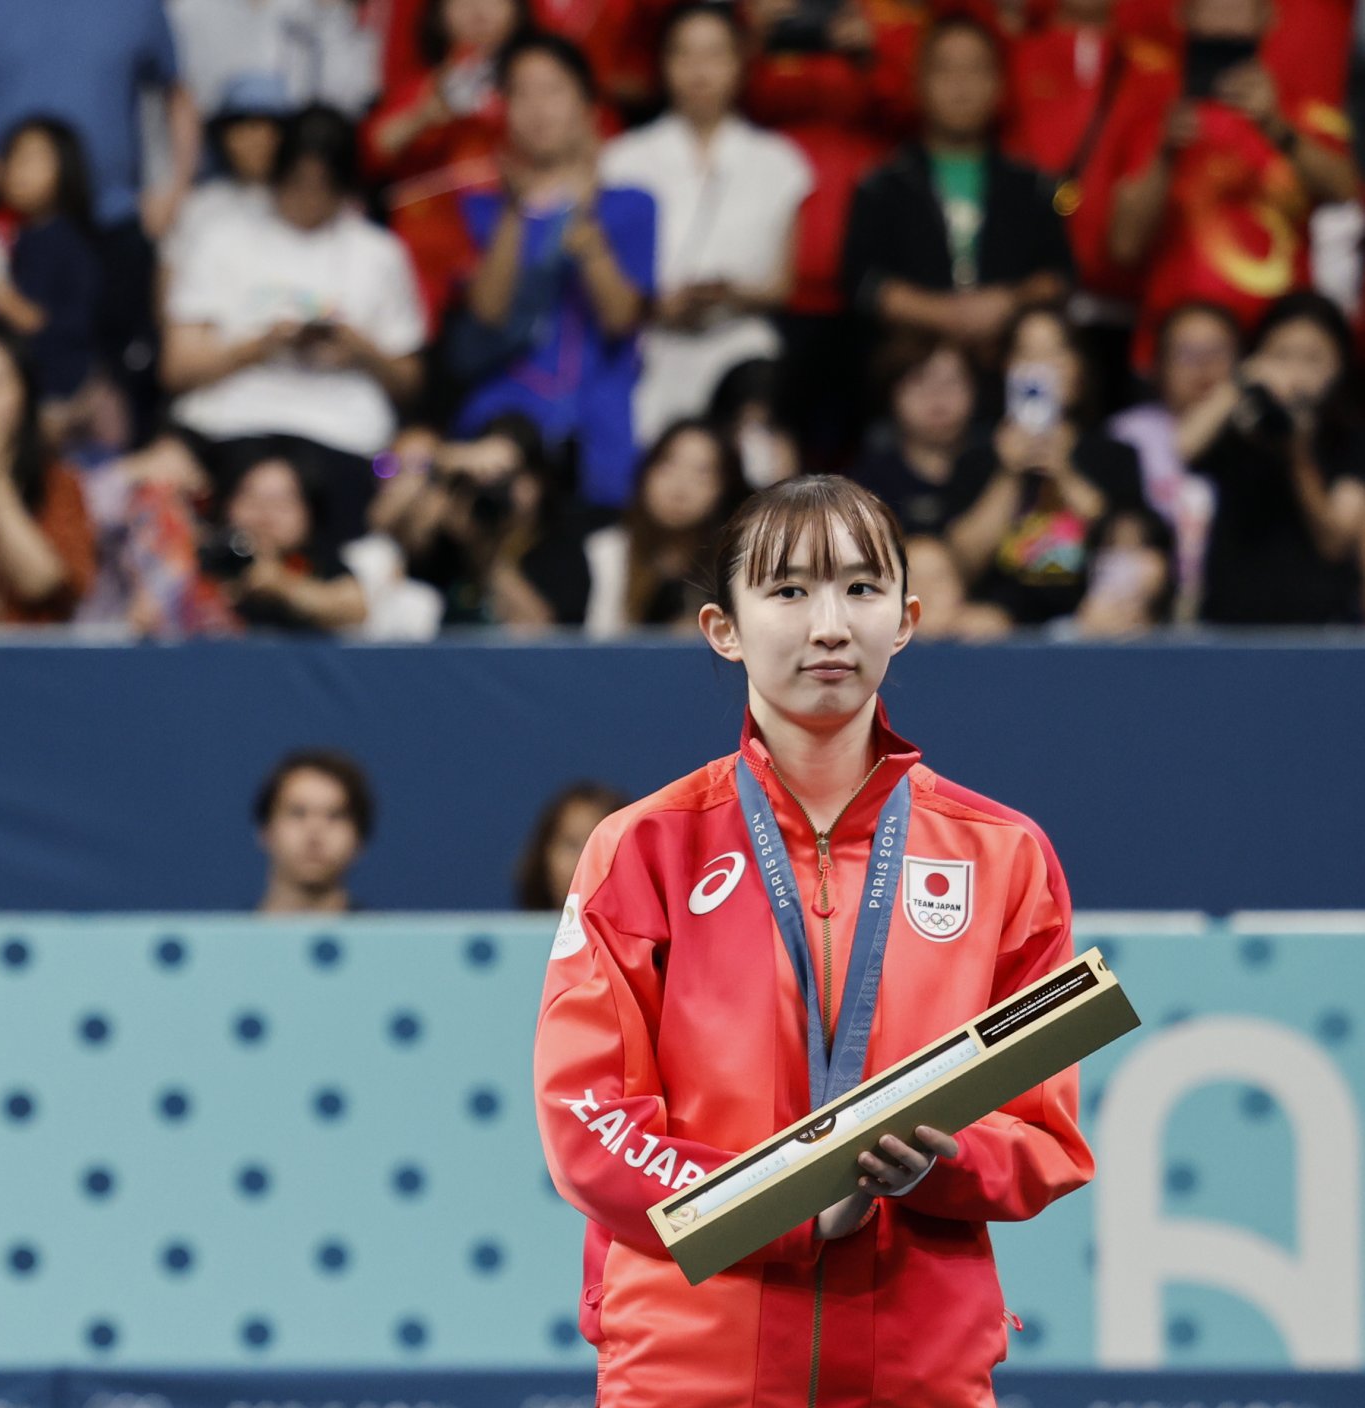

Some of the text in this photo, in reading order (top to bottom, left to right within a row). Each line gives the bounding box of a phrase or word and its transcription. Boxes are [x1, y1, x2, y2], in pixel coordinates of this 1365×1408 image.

[752, 812, 791, 909] PARIS 2024
[868, 815, 898, 909] PARIS 2024
[913, 898, 962, 912] TEAM JAPAN
